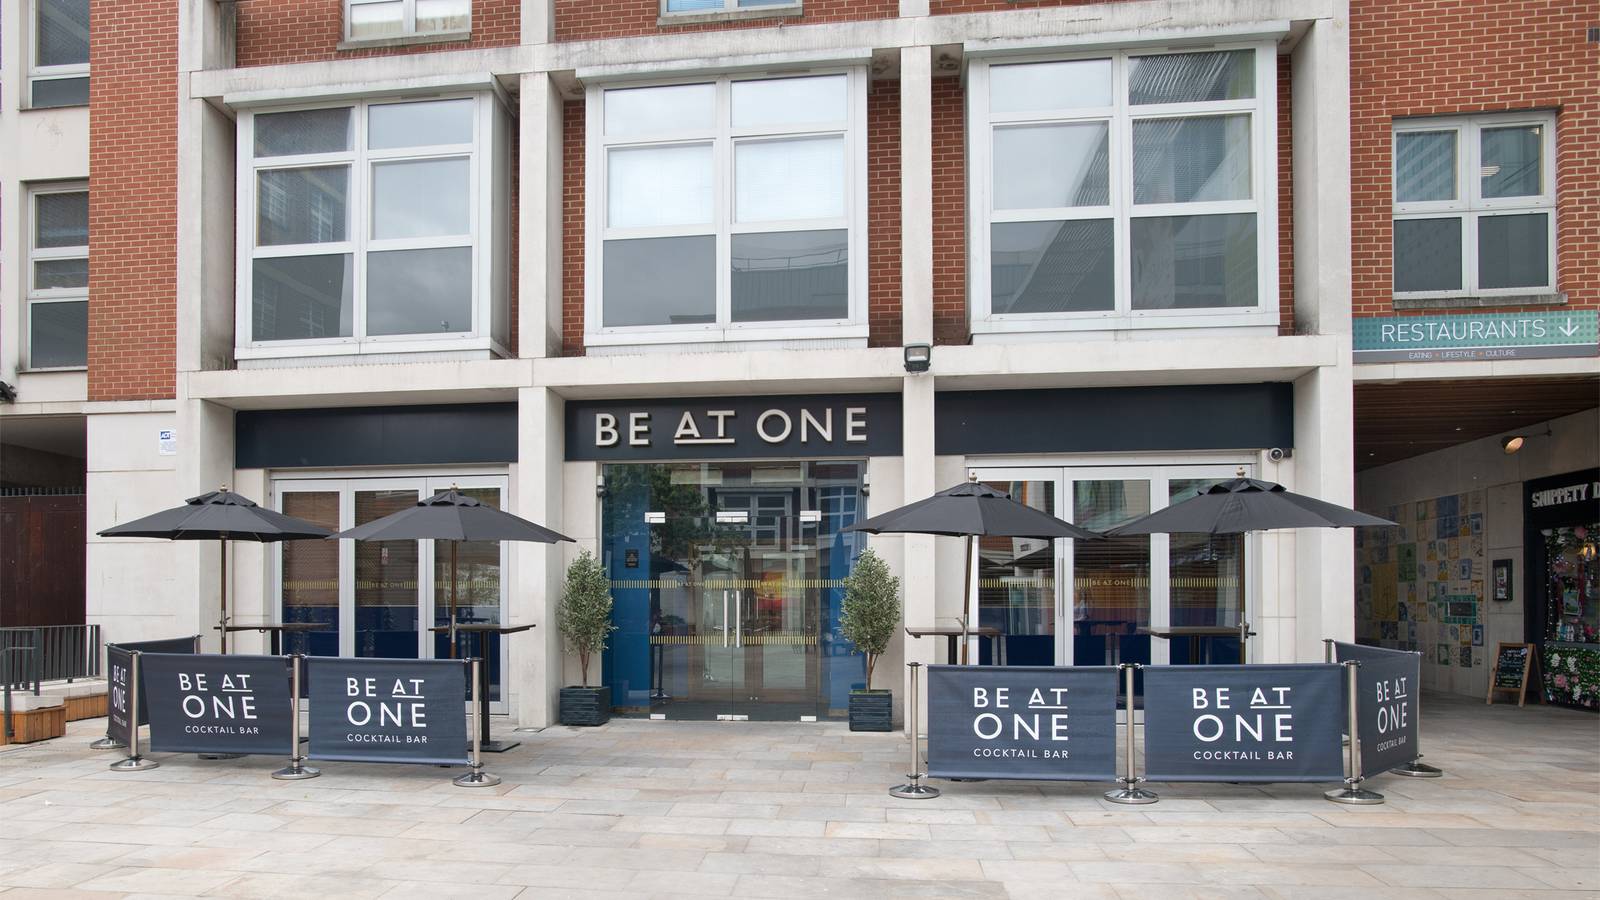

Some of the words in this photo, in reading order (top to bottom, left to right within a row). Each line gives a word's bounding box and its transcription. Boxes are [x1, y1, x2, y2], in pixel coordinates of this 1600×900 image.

[1381, 319, 1546, 343] RESTAURANTS
[1409, 352, 1432, 360] EATING
[1441, 350, 1476, 359] LIFESTYLE
[1485, 349, 1516, 357] CULTURE
[596, 413, 648, 445] BE
[674, 411, 735, 443] AT
[757, 408, 866, 442] ONE
[1532, 483, 1589, 508] SNIPPETY
[178, 673, 208, 691] BE
[222, 674, 252, 692] AT
[347, 678, 376, 696] BE
[392, 679, 424, 698] AT
[1377, 680, 1390, 703] BE
[1395, 677, 1407, 699] AT
[183, 695, 257, 719] ONE
[974, 688, 1009, 707] BE
[1029, 688, 1067, 708] AT
[1193, 688, 1230, 709] BE
[1250, 688, 1291, 708] AT
[348, 701, 426, 727] ONE
[1377, 702, 1408, 733] ONE
[186, 726, 235, 734] COCKTAIL
[240, 727, 259, 735] BAR
[974, 713, 1068, 740] ONE
[1194, 714, 1292, 741] ONE
[347, 733, 401, 743] COCKTAIL
[406, 735, 428, 744] BAR
[974, 749, 1037, 757] COCKTAIL
[1045, 750, 1068, 758] BAR
[1194, 751, 1260, 759] COCKTAIL
